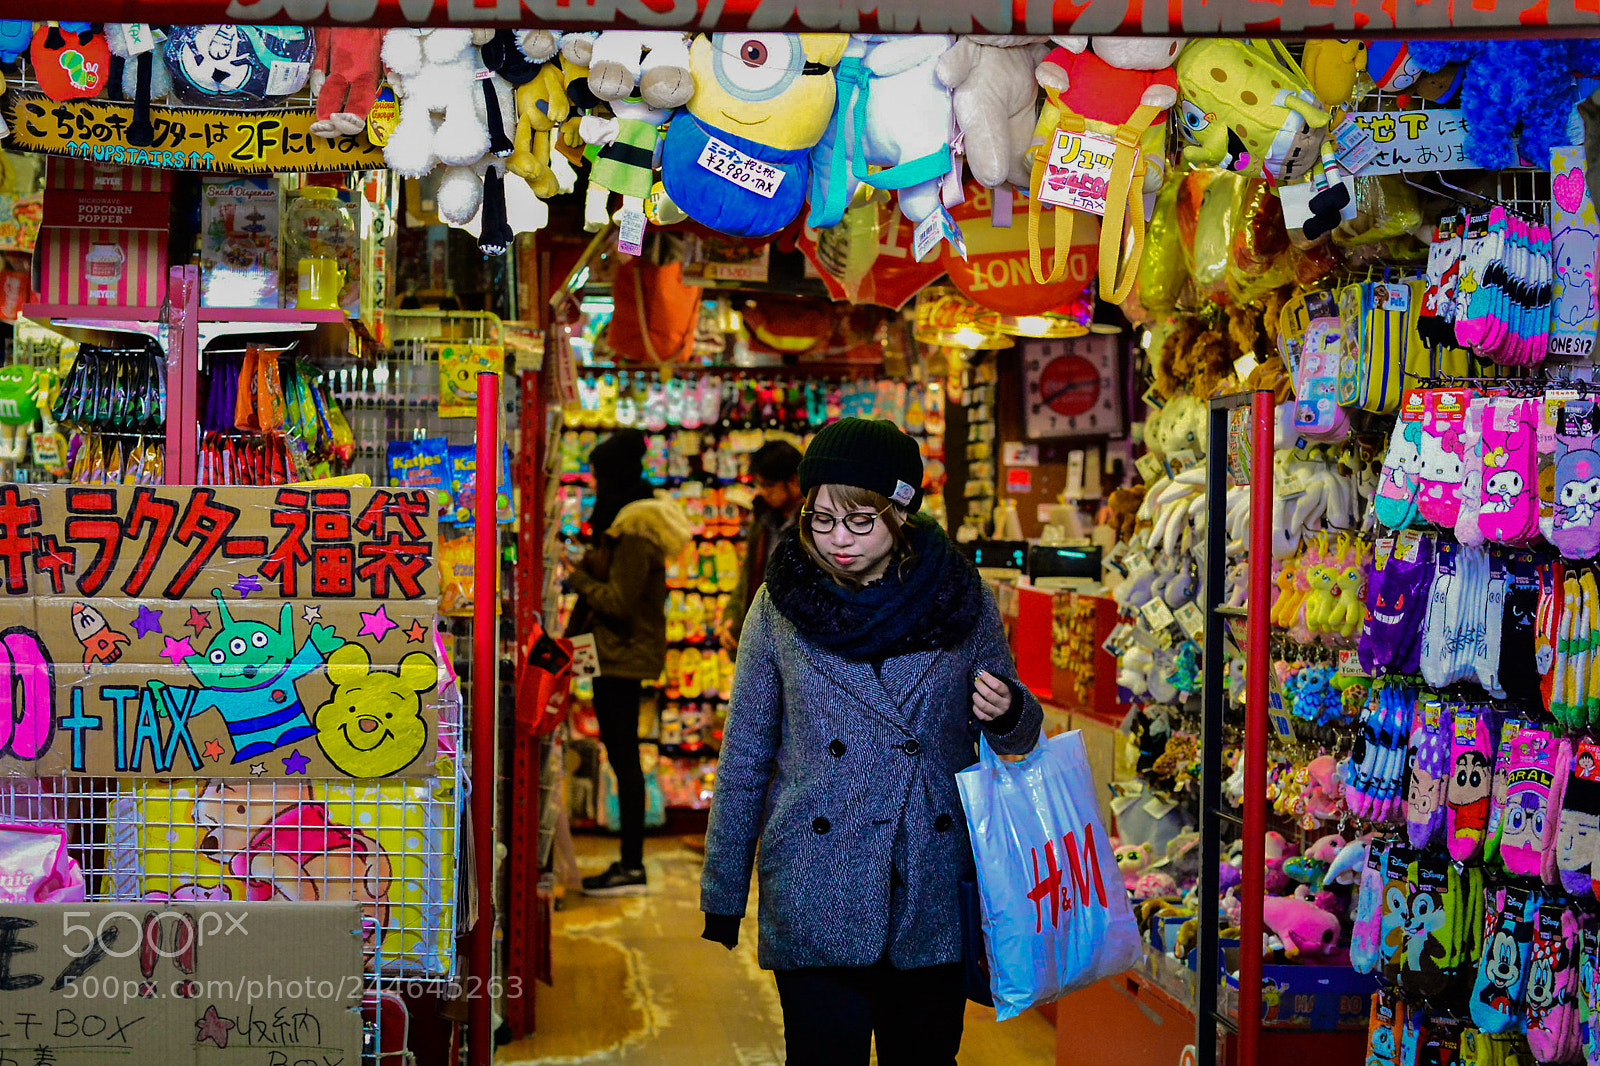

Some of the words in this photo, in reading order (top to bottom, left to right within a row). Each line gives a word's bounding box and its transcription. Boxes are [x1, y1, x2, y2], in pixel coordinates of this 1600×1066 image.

[371, 110, 395, 121] George
[93, 144, 186, 169] UPSTAIRS
[1058, 134, 1115, 170] リュッ
[207, 186, 234, 198] Snack
[235, 186, 276, 201] Dispenser
[78, 204, 133, 215] POPCORN
[78, 214, 123, 225] POPPER
[968, 257, 1030, 292] NOT
[89, 289, 117, 299] MEYER
[1551, 337, 1572, 353] ONE
[392, 453, 442, 470] Katjes
[0, 484, 432, 600] キャラクター福袋
[58, 684, 204, 772] +TAX
[1506, 769, 1555, 786] ARAL
[1027, 822, 1108, 934] H&M
[1420, 868, 1445, 882] Disney
[1540, 914, 1560, 930] Disney
[53, 1008, 145, 1043] BOX
